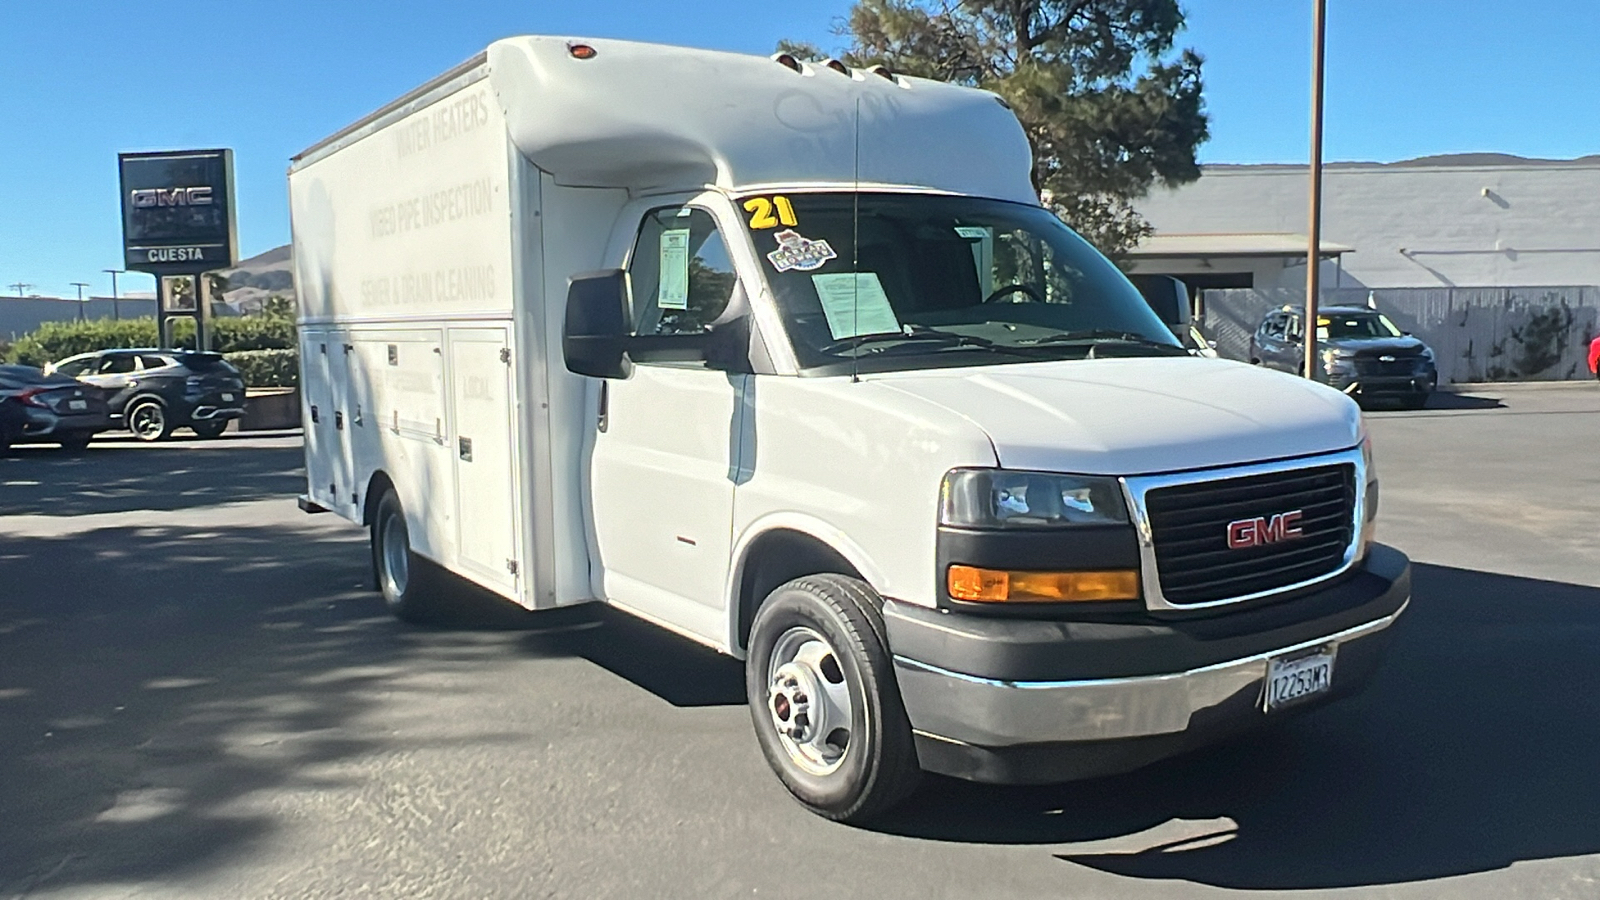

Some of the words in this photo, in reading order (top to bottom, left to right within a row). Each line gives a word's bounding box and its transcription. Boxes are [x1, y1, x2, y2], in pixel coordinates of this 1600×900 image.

[432, 89, 489, 144] HEATERS
[132, 186, 212, 207] GMC
[398, 197, 421, 233] PIPE
[423, 177, 493, 227] INSPECTION
[743, 195, 798, 230] 21
[148, 247, 204, 262] CUESTA
[434, 264, 495, 302] CLEANING
[1227, 510, 1302, 549] GMC
[1273, 664, 1328, 700] 12253M3
